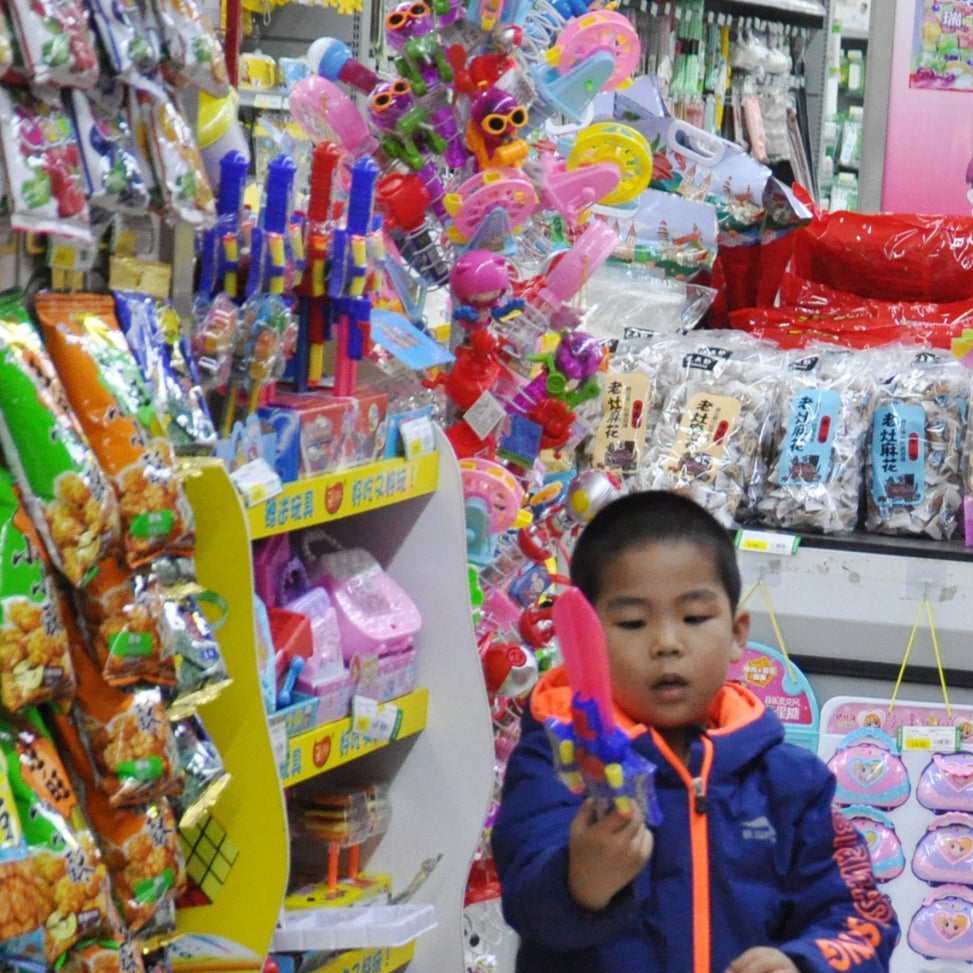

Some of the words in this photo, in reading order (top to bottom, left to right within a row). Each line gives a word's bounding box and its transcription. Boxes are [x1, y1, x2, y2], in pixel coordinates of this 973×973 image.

[605, 381, 623, 439] 老灶麻花
[879, 412, 899, 473] 老灶麻花
